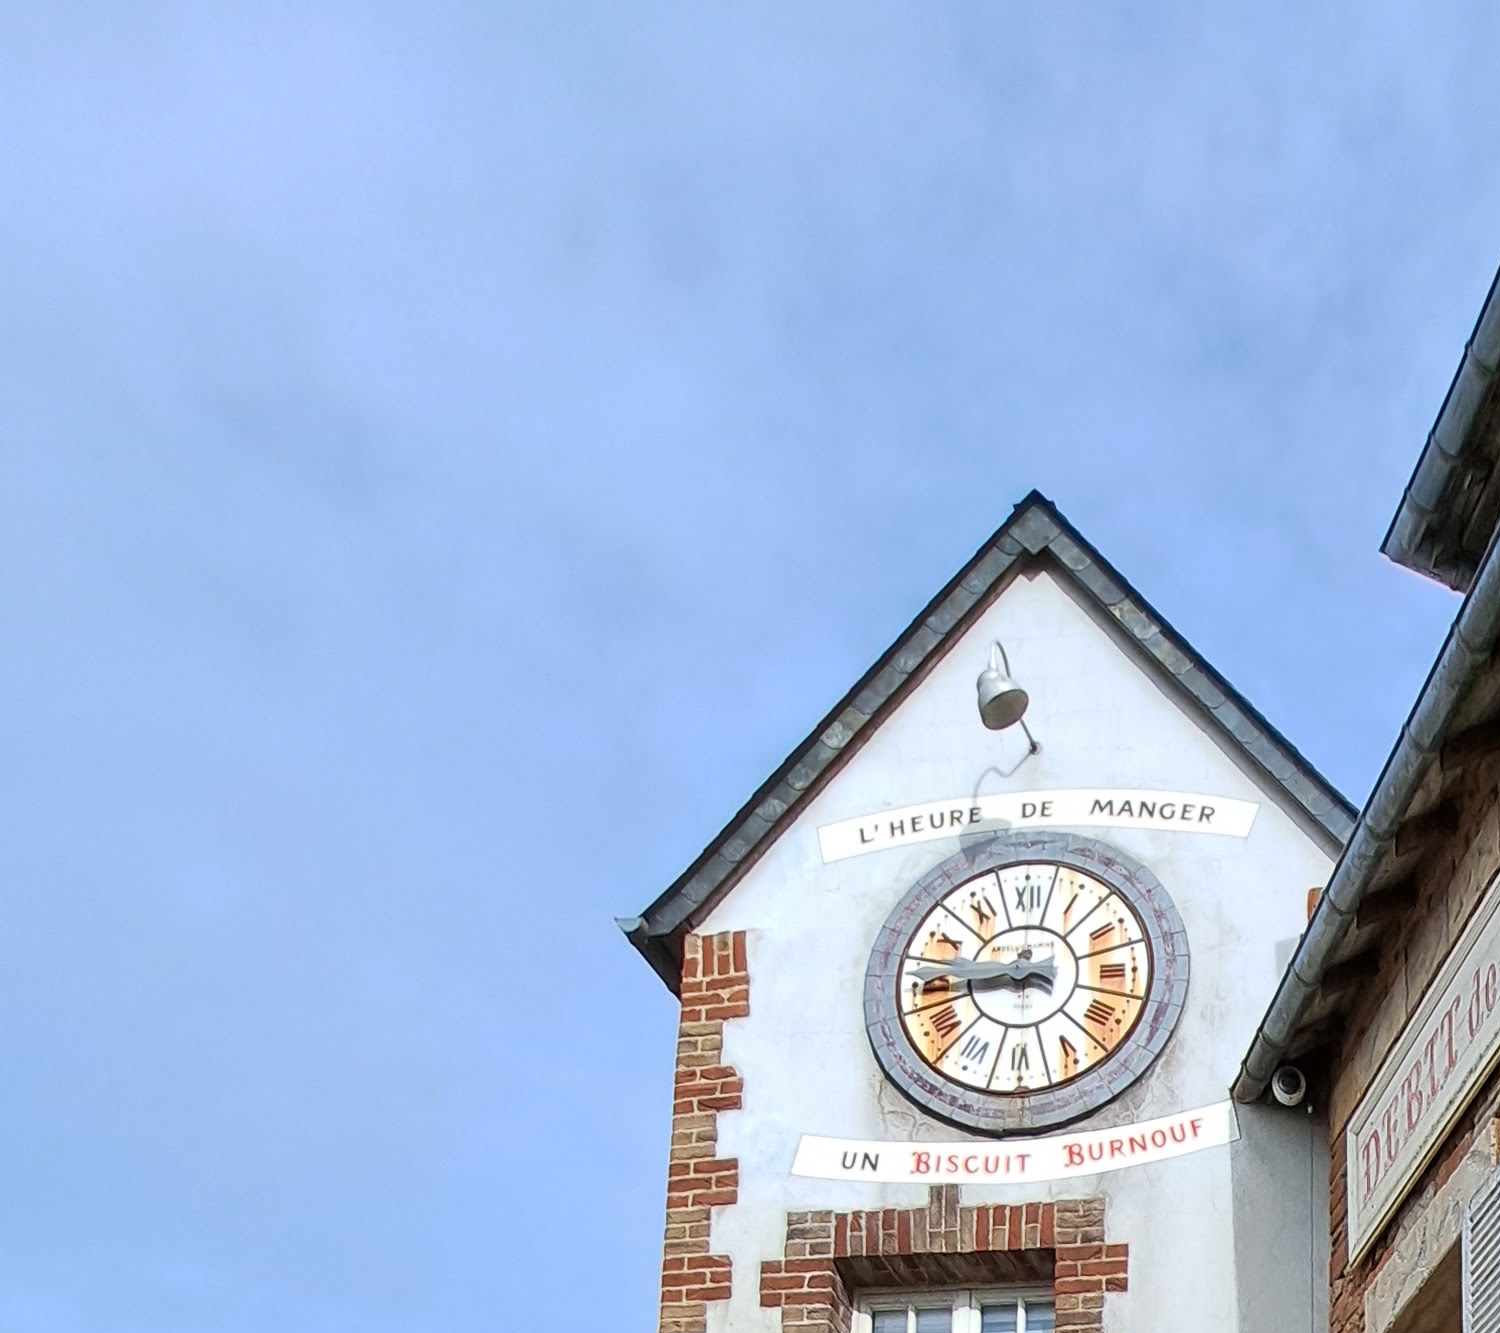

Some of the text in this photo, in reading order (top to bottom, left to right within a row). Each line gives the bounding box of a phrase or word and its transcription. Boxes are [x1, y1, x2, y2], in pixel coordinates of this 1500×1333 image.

[860, 799, 1216, 844] L'HEURE DE MANGER
[1468, 962, 1498, 1040] de
[841, 1118, 1204, 1175] UN BISCUIT BURNOUF
